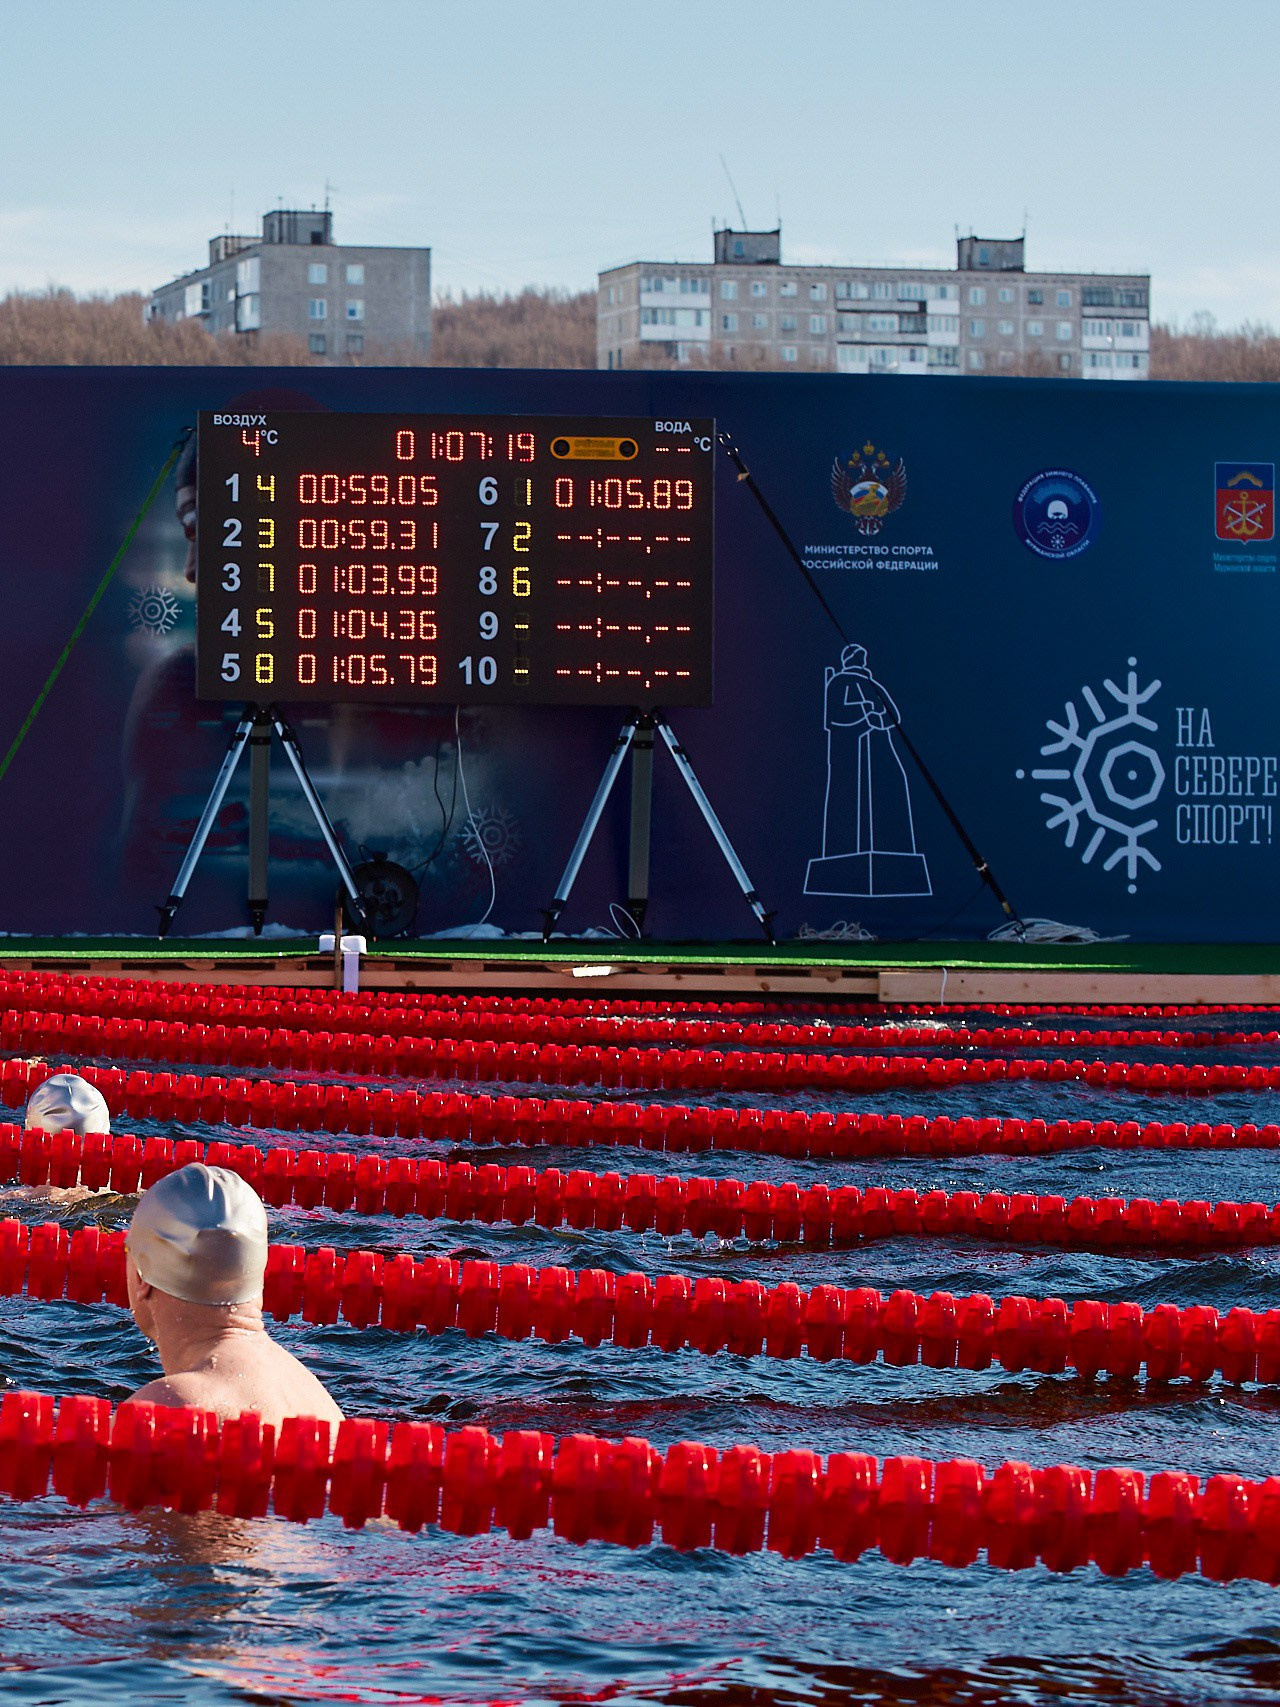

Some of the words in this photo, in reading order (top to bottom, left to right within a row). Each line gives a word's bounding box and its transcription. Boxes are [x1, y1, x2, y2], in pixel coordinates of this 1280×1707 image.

[213, 414, 267, 427] ВОЗДУХ
[655, 421, 692, 434] ВОДА
[242, 429, 260, 457] 4
[226, 473, 239, 502] 1
[256, 474, 276, 502] 4
[299, 474, 438, 506] 00:59.05
[478, 476, 498, 506] 6
[555, 477, 693, 510] 01:05.89
[222, 518, 242, 547] 2
[258, 518, 275, 549] 3
[299, 518, 438, 550] 00:59.31
[480, 522, 500, 551] 7
[513, 521, 532, 552] 2
[804, 545, 889, 555] МИНИСТЕРСТВО
[891, 545, 933, 556] СПОРТА
[875, 560, 939, 571] ФЕДЕРАЦИИ
[221, 562, 241, 592] 3
[257, 563, 275, 592] 7
[298, 563, 438, 596] 01:03.99
[478, 566, 498, 595] 8
[512, 566, 531, 597] 6
[221, 608, 241, 637] 4
[255, 607, 275, 639] 5
[298, 608, 437, 641] 01:04.36
[479, 611, 499, 640] 9
[220, 653, 241, 682] 5
[255, 653, 274, 684] 8
[298, 653, 437, 686] 01:05.79
[458, 656, 497, 685] 10
[1175, 707, 1215, 747] НА
[1174, 755, 1278, 797] СЕВЕРЕ
[1176, 803, 1273, 845] СПОРТ!
